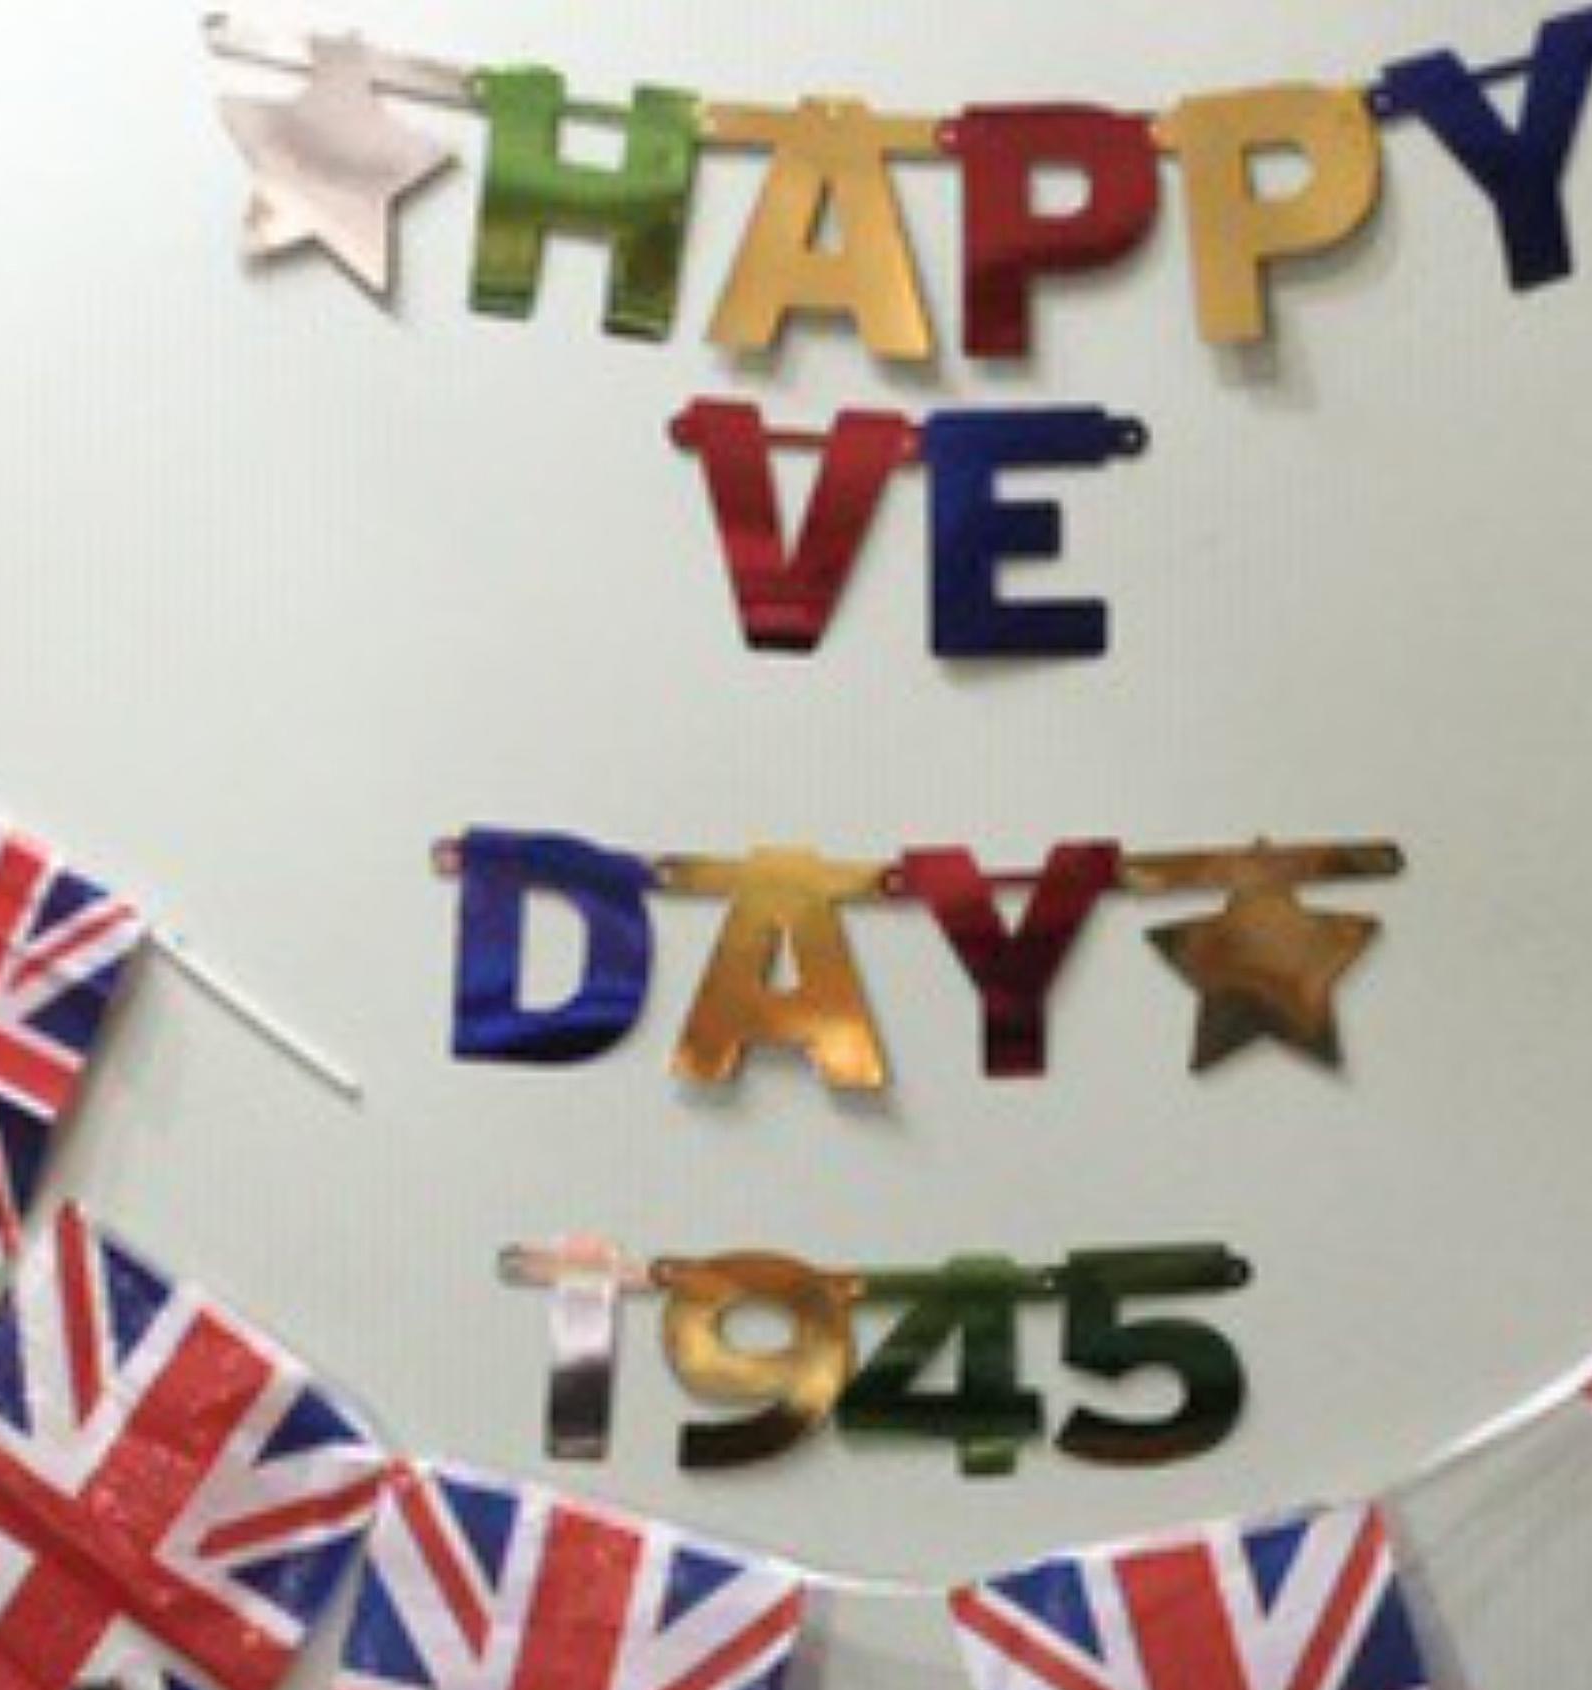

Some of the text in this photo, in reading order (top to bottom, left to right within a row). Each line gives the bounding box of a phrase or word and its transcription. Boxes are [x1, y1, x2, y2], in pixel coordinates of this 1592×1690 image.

[674, 399, 1134, 658] VE
[449, 826, 1123, 1092] DAY
[514, 1234, 1250, 1477] 1945
